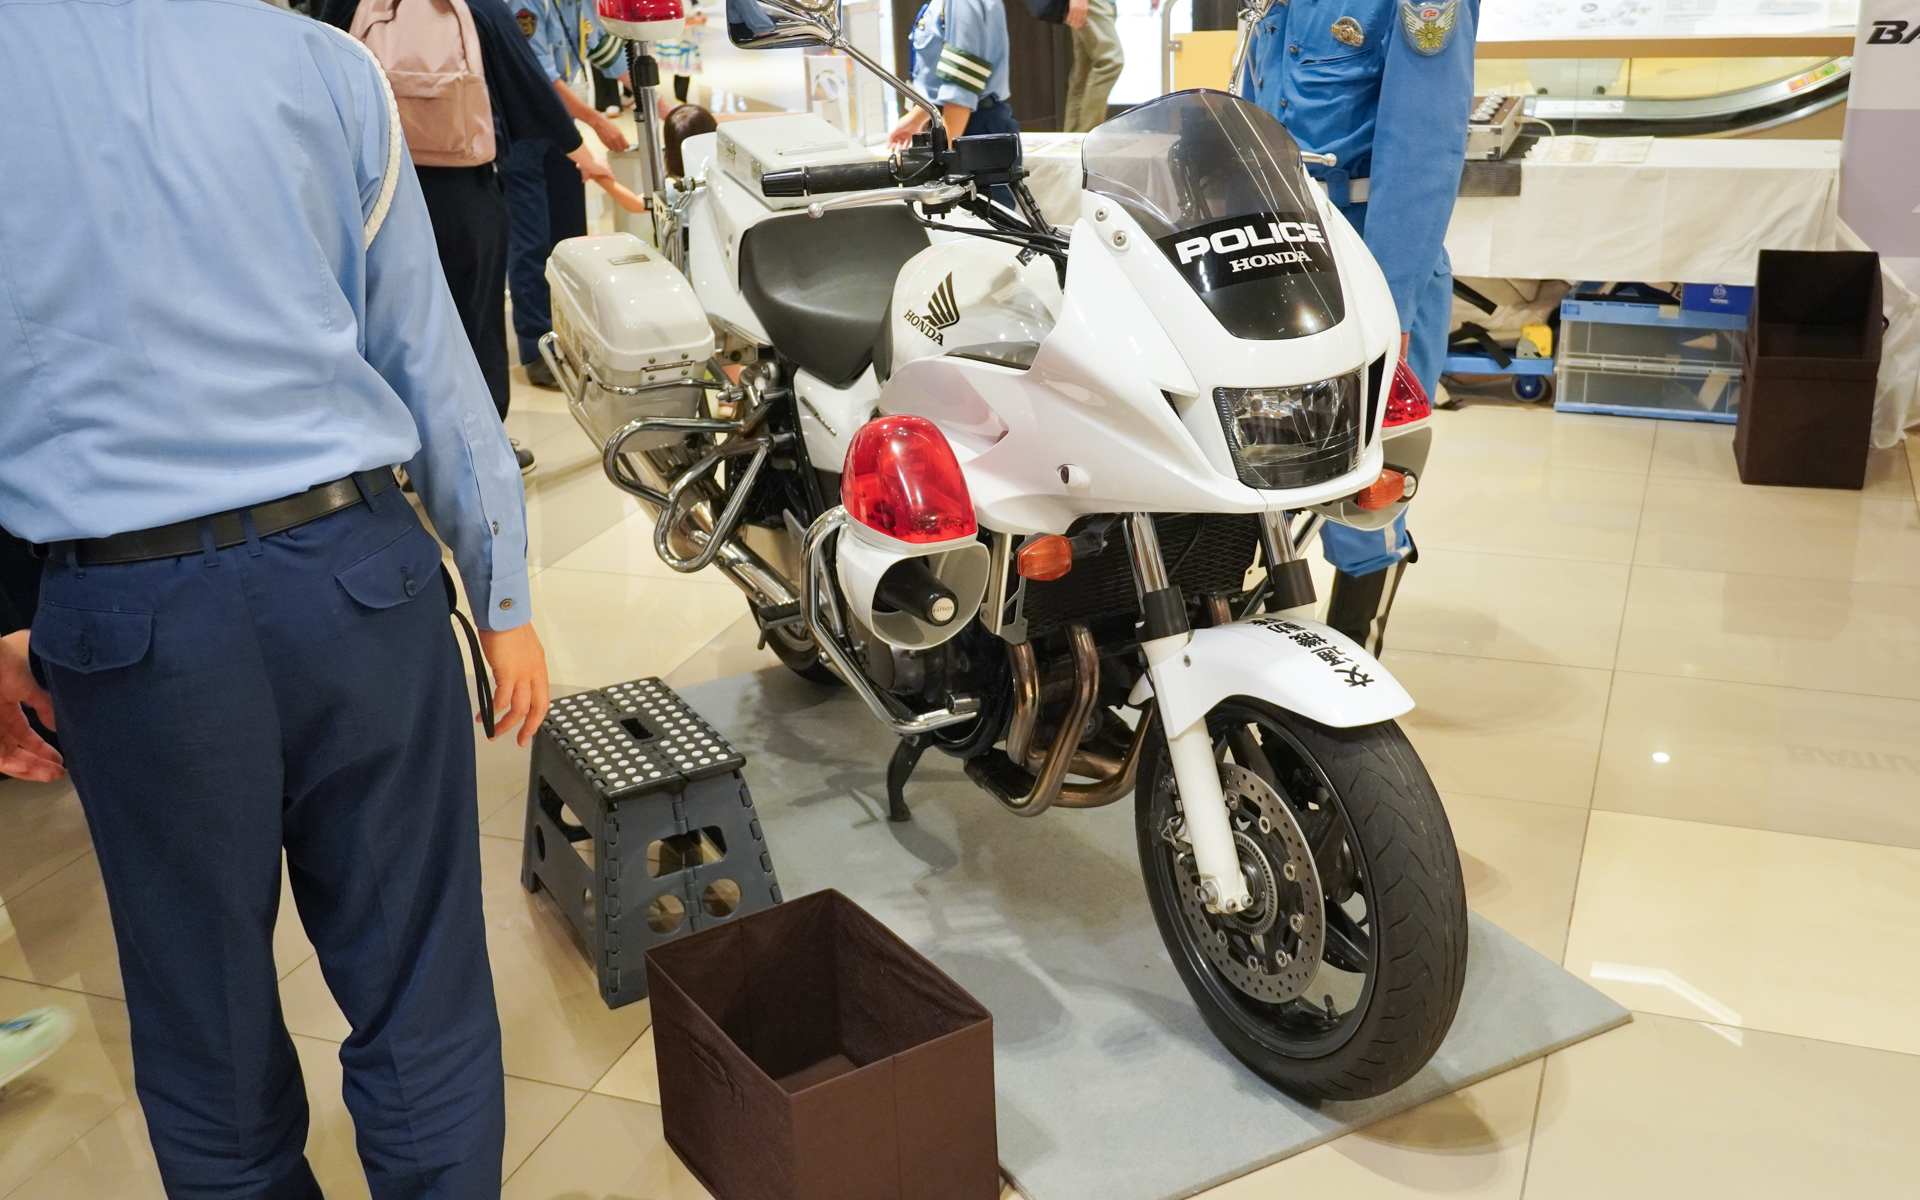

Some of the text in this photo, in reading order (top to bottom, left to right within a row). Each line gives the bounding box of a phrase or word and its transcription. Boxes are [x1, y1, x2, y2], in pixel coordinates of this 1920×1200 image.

[1175, 222, 1326, 265] POLICE
[1229, 251, 1312, 273] HONDA
[904, 309, 944, 346] HONDA
